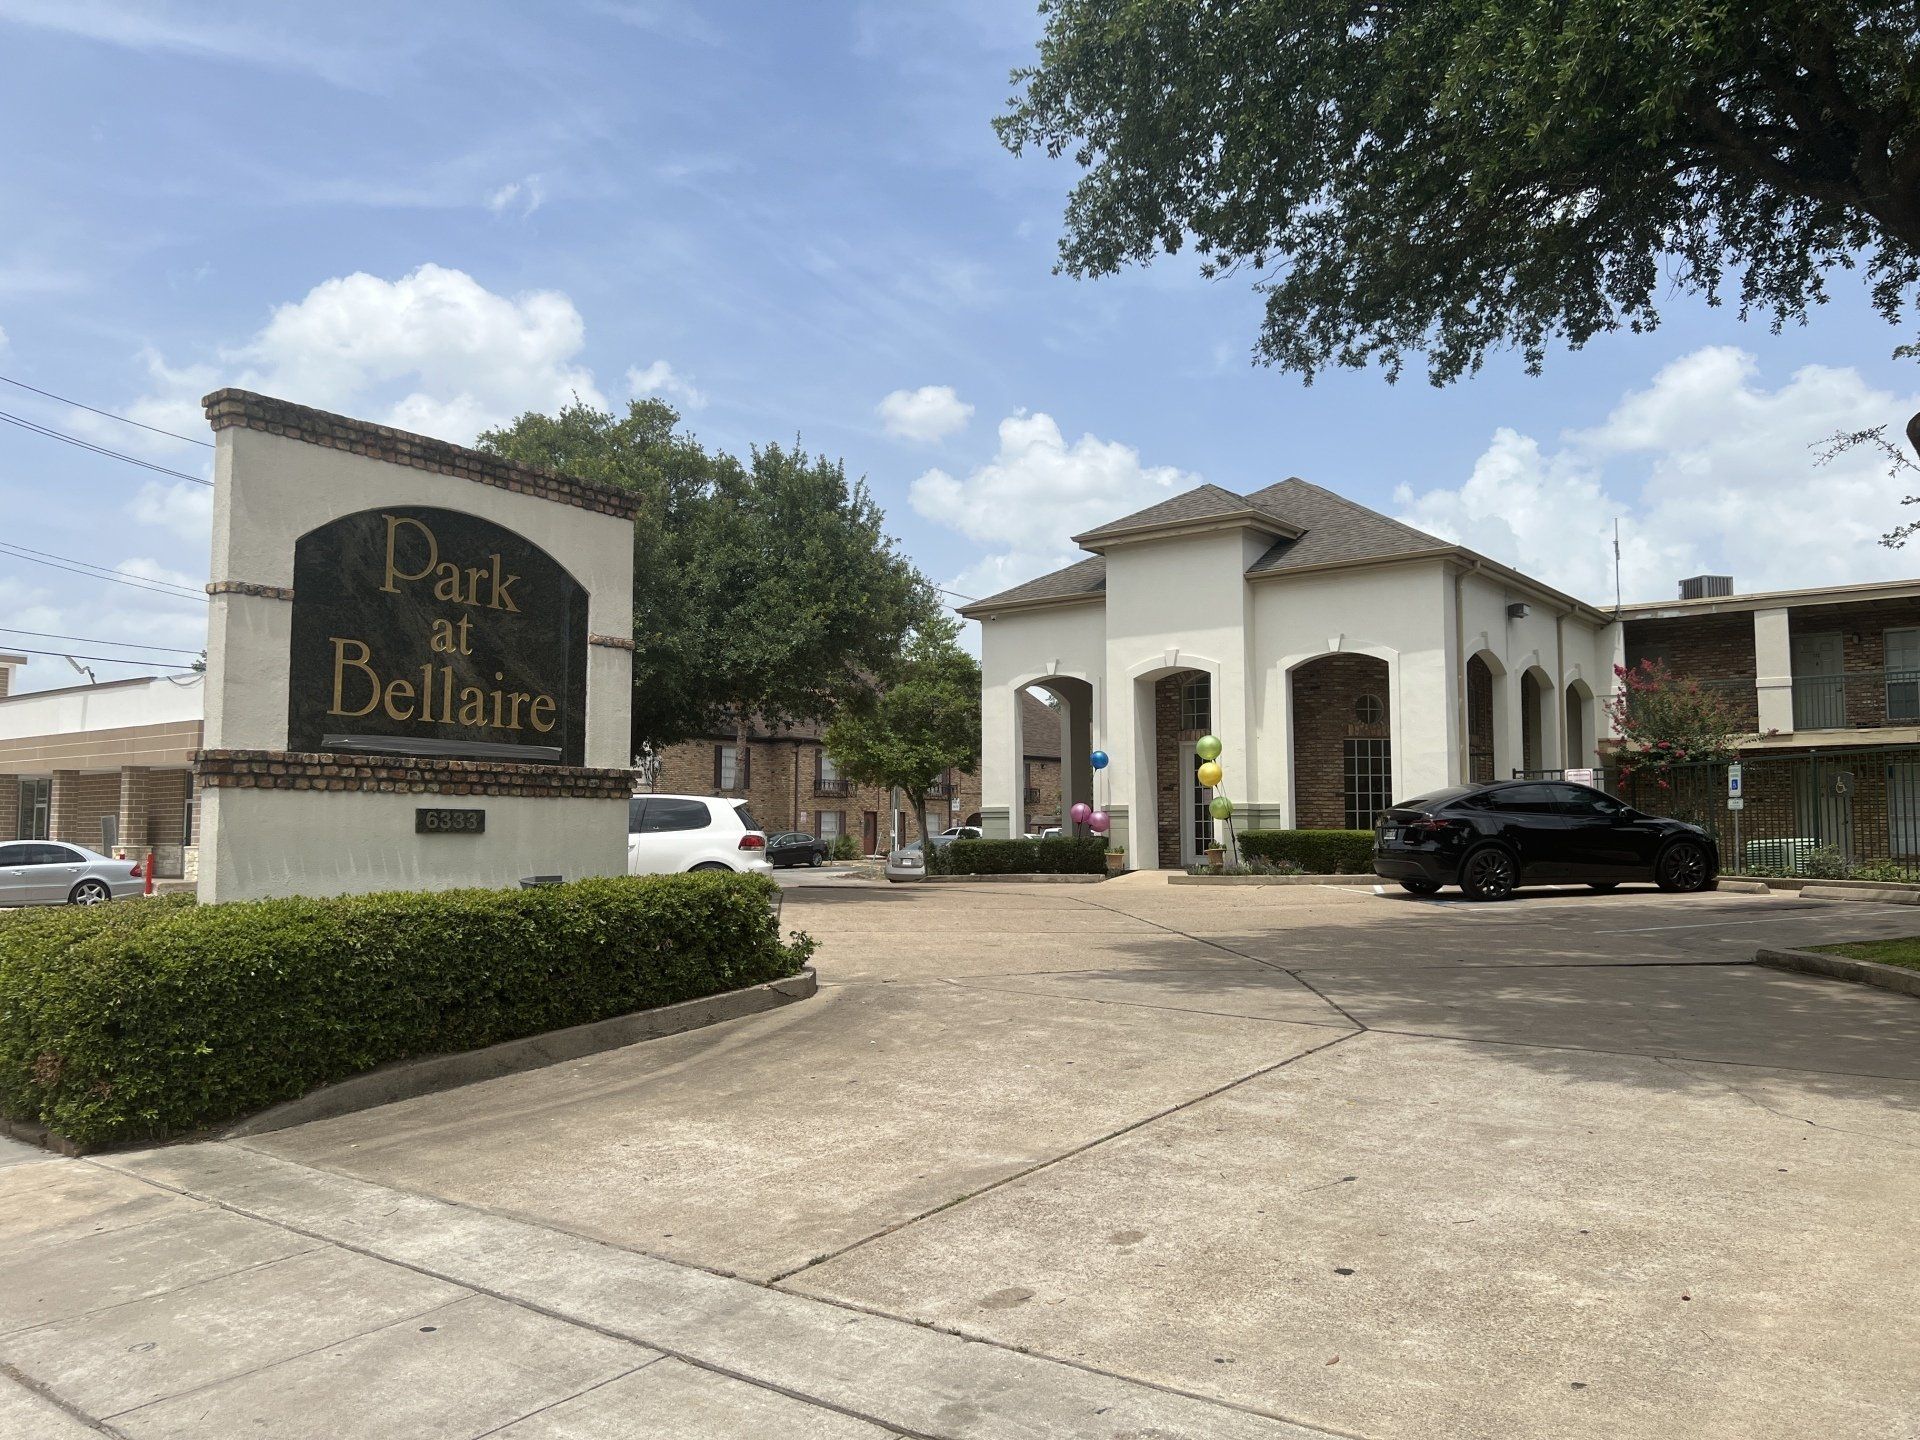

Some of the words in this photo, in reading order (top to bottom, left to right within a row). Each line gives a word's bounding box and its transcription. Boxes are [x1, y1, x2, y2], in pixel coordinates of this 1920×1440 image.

[379, 514, 522, 613] Park
[430, 612, 473, 656] at
[327, 637, 557, 733] Bellaire
[426, 811, 478, 829] 6333
